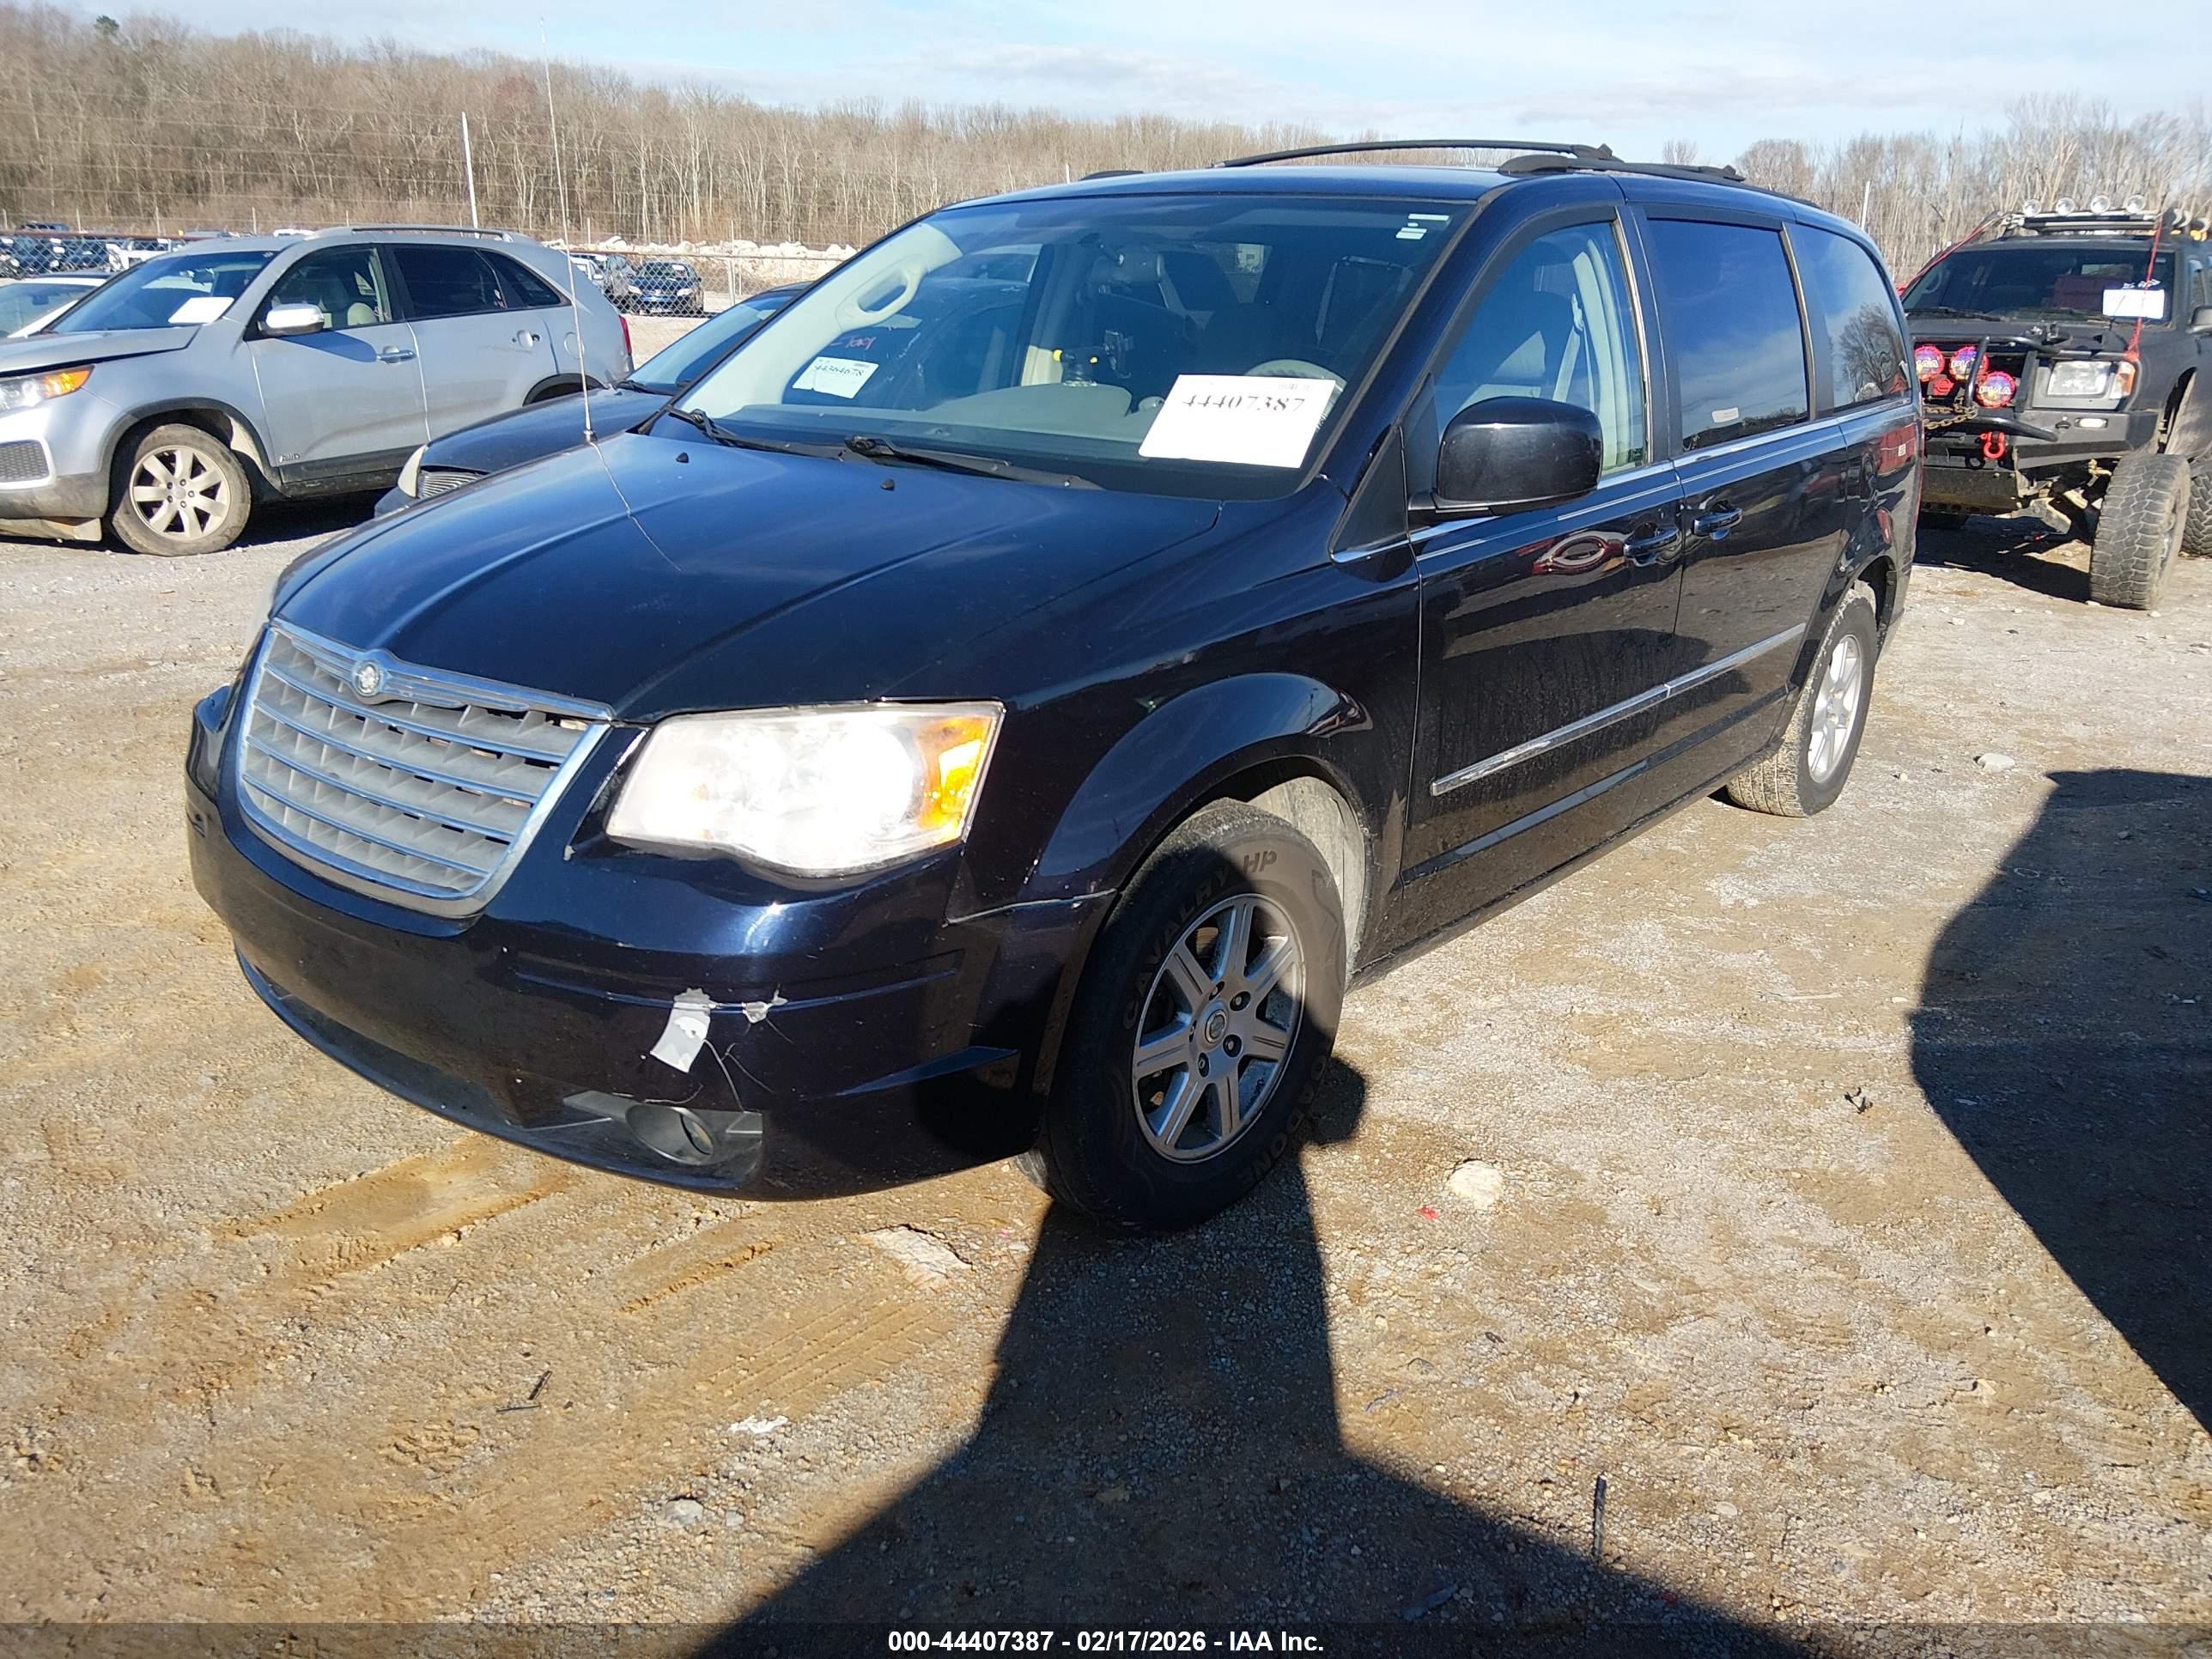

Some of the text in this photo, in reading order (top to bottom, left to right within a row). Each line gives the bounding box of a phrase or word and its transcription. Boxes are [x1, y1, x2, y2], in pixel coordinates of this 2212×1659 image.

[1181, 393, 1306, 412] 44407387
[1122, 849, 1279, 1030] CAVALRY HP
